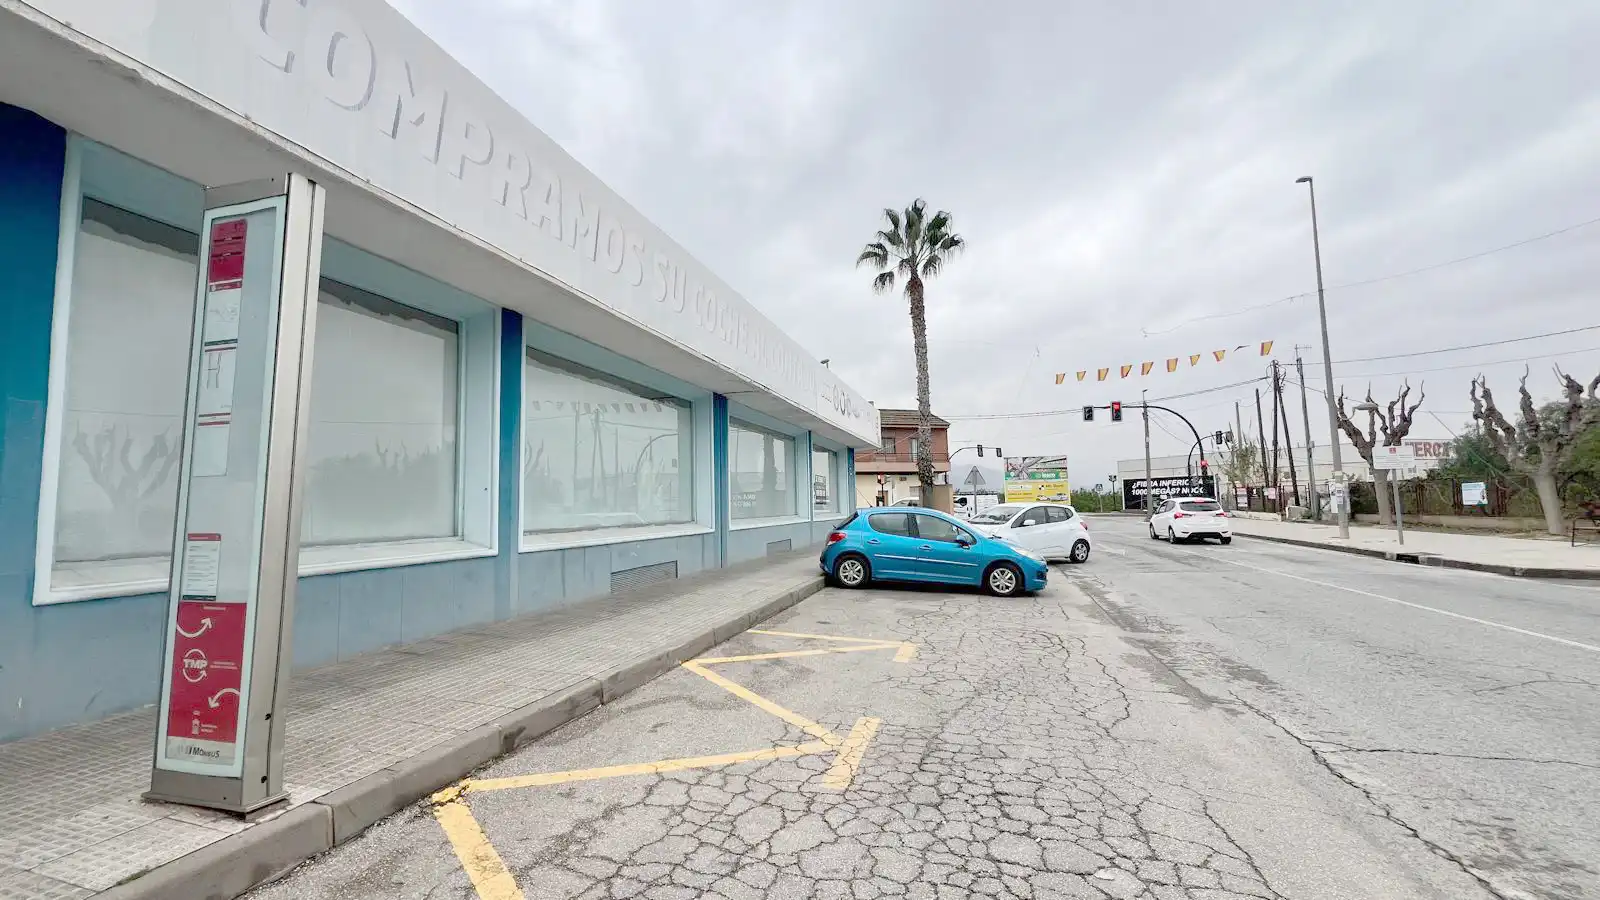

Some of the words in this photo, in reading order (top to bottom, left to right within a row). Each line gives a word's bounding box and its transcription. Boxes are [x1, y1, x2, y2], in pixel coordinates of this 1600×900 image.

[250, 0, 645, 287] COMPRAMOS
[655, 254, 686, 313] SU
[695, 283, 749, 355] COCHE
[1160, 479, 1196, 487] INFERIO
[183, 659, 208, 669] TMP
